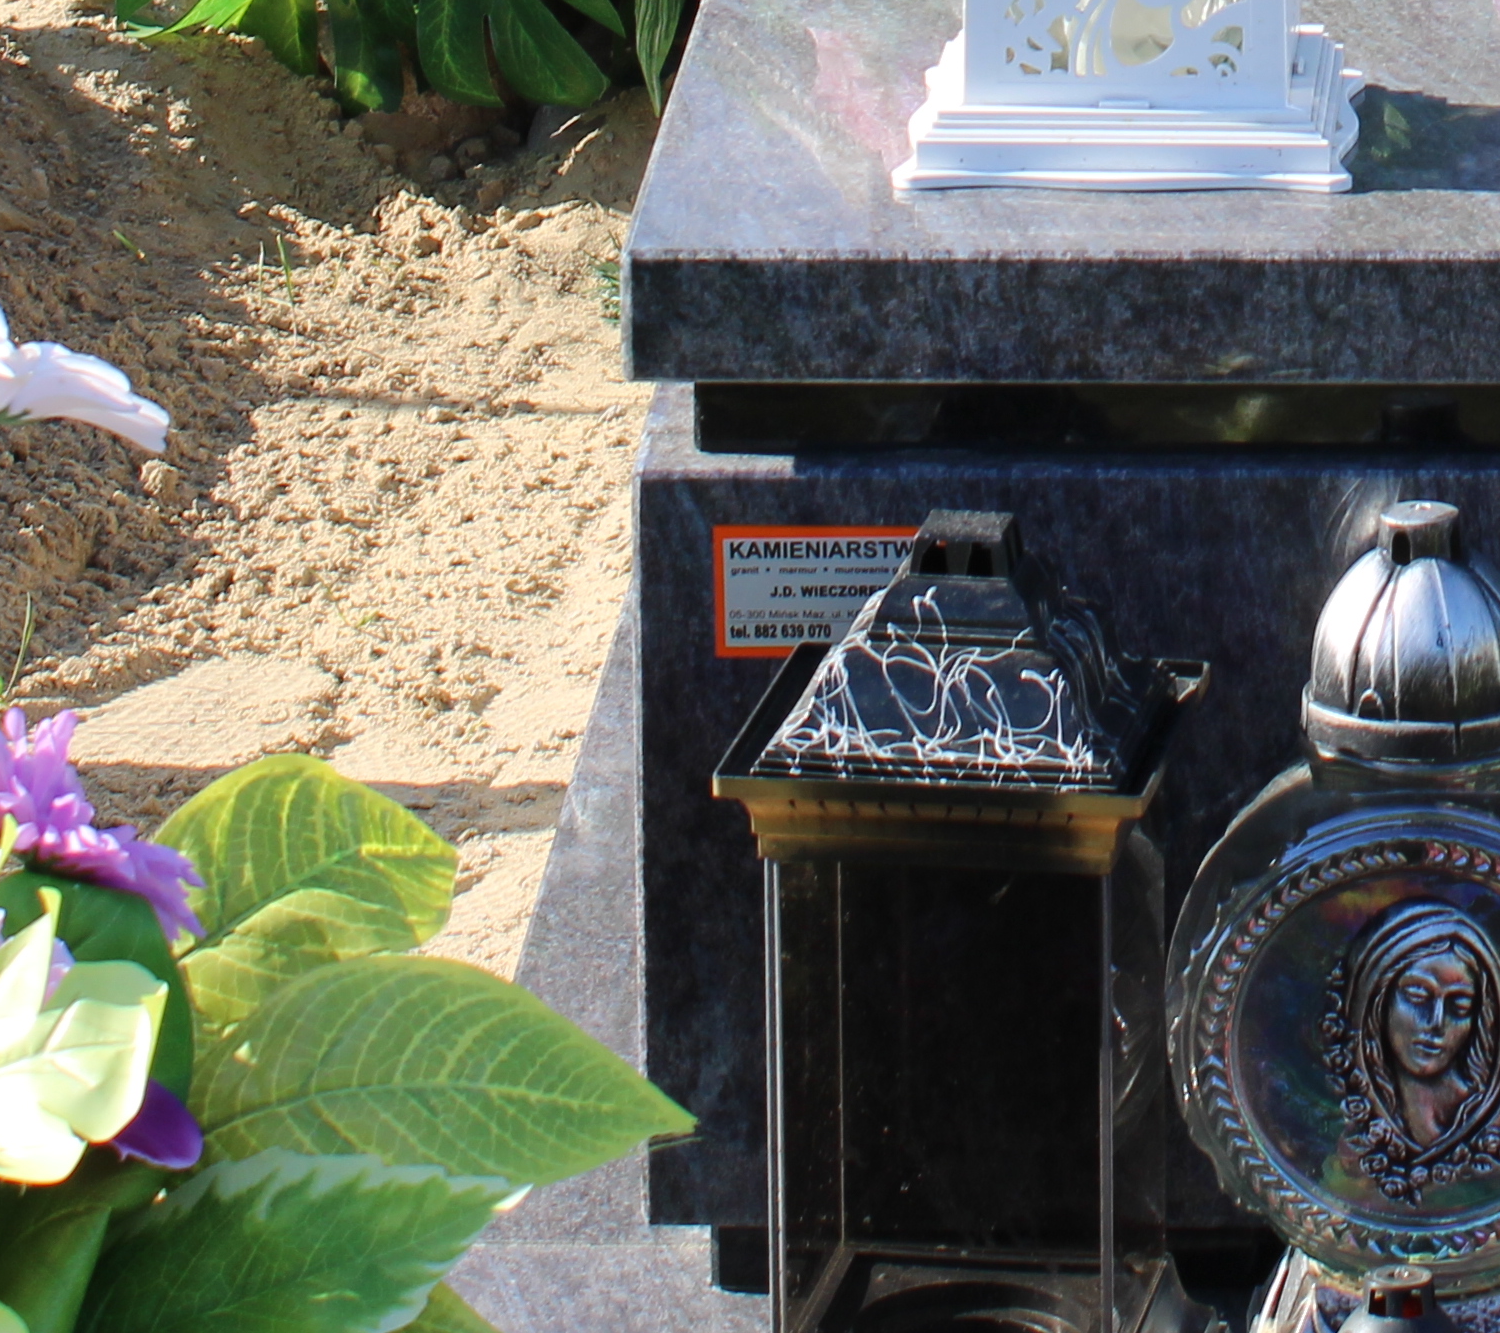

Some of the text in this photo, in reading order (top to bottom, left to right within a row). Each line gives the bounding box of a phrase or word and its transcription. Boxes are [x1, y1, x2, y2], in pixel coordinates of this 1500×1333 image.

[730, 566, 760, 576] granit
[778, 566, 818, 575] marmur
[770, 585, 797, 598] J.D.
[730, 624, 832, 639] tel. 882 639 070
